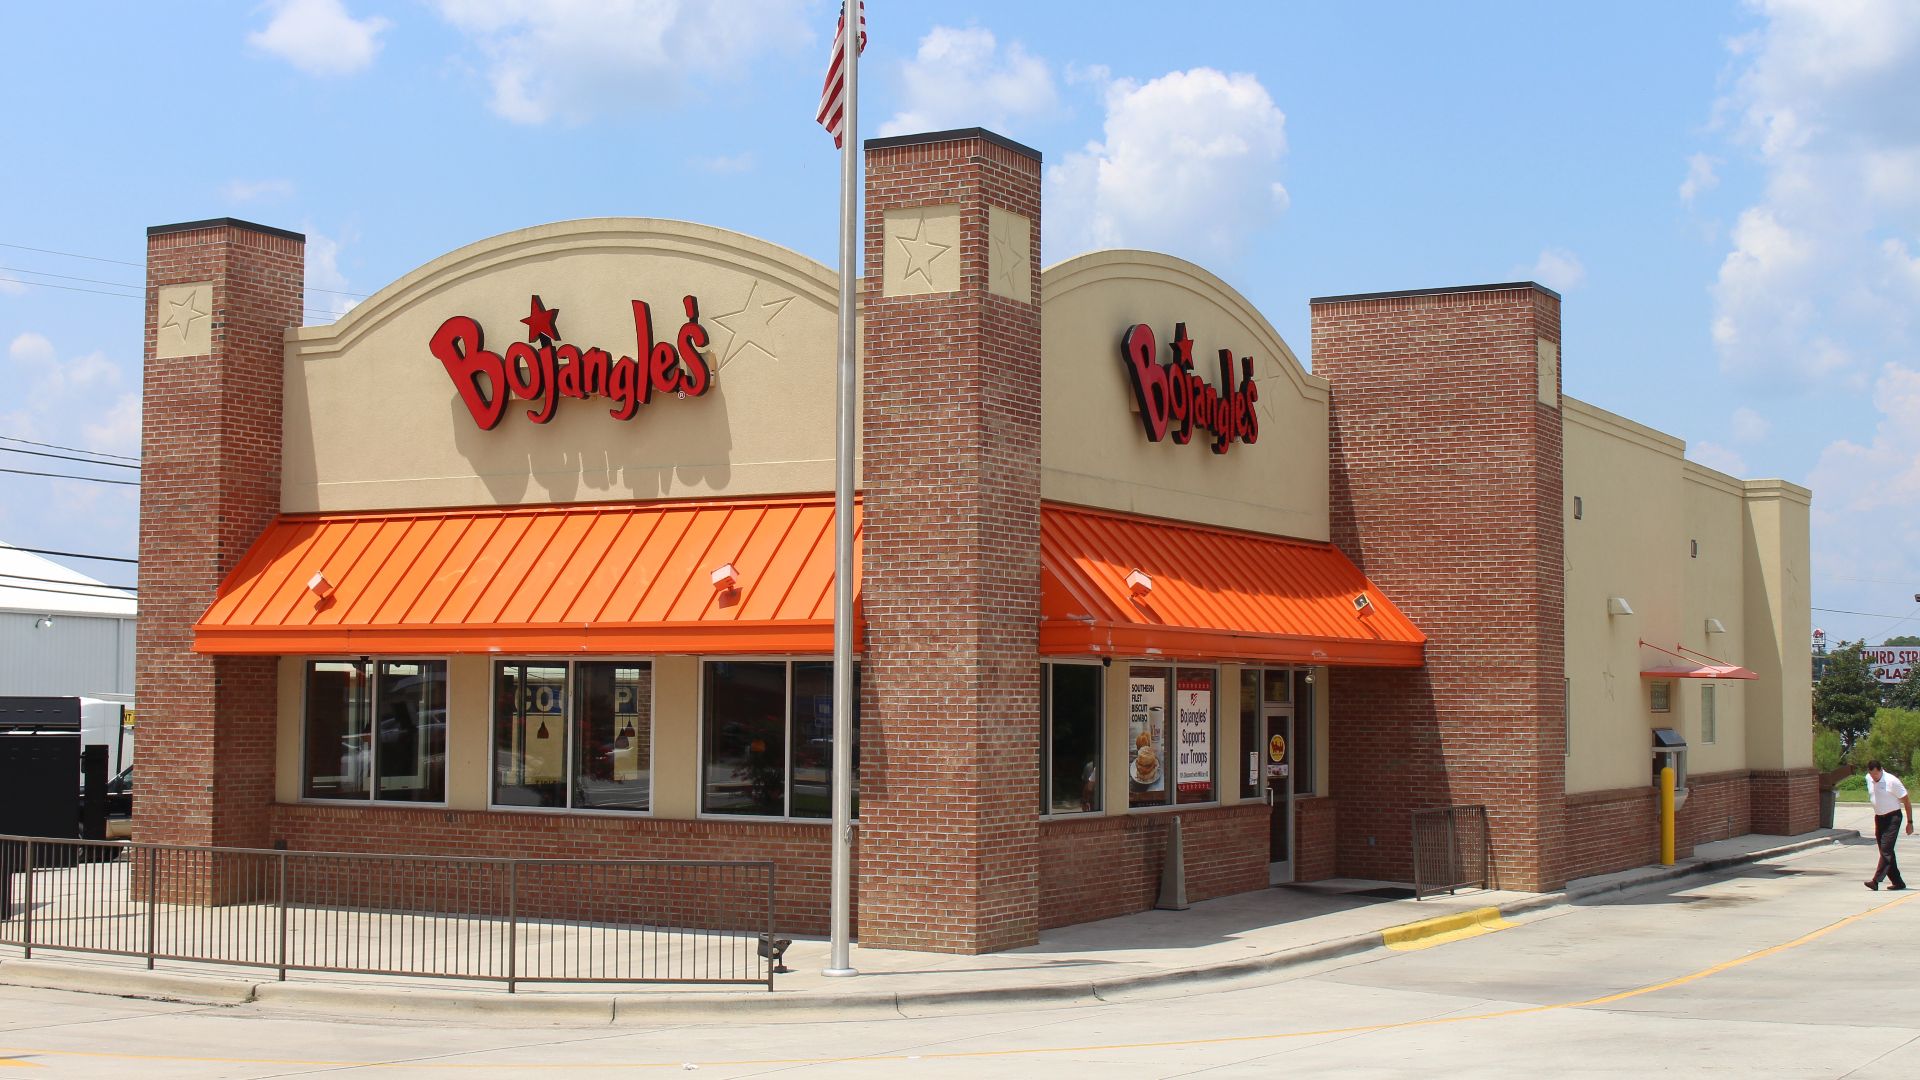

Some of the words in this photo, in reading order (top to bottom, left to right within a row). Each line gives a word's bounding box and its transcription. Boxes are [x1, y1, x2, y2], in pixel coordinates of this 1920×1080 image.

[1861, 650, 1895, 664] THIRD
[1899, 650, 1920, 664] STR
[1875, 668, 1911, 679] PLAZ
[1131, 684, 1155, 692] SOUTHERN
[1131, 694, 1142, 702] FILET
[1131, 704, 1148, 712] BISCUIT
[1131, 714, 1148, 722] COMBO
[1182, 729, 1206, 746] Supports
[1180, 752, 1190, 764] our
[1190, 749, 1208, 766] Troops
